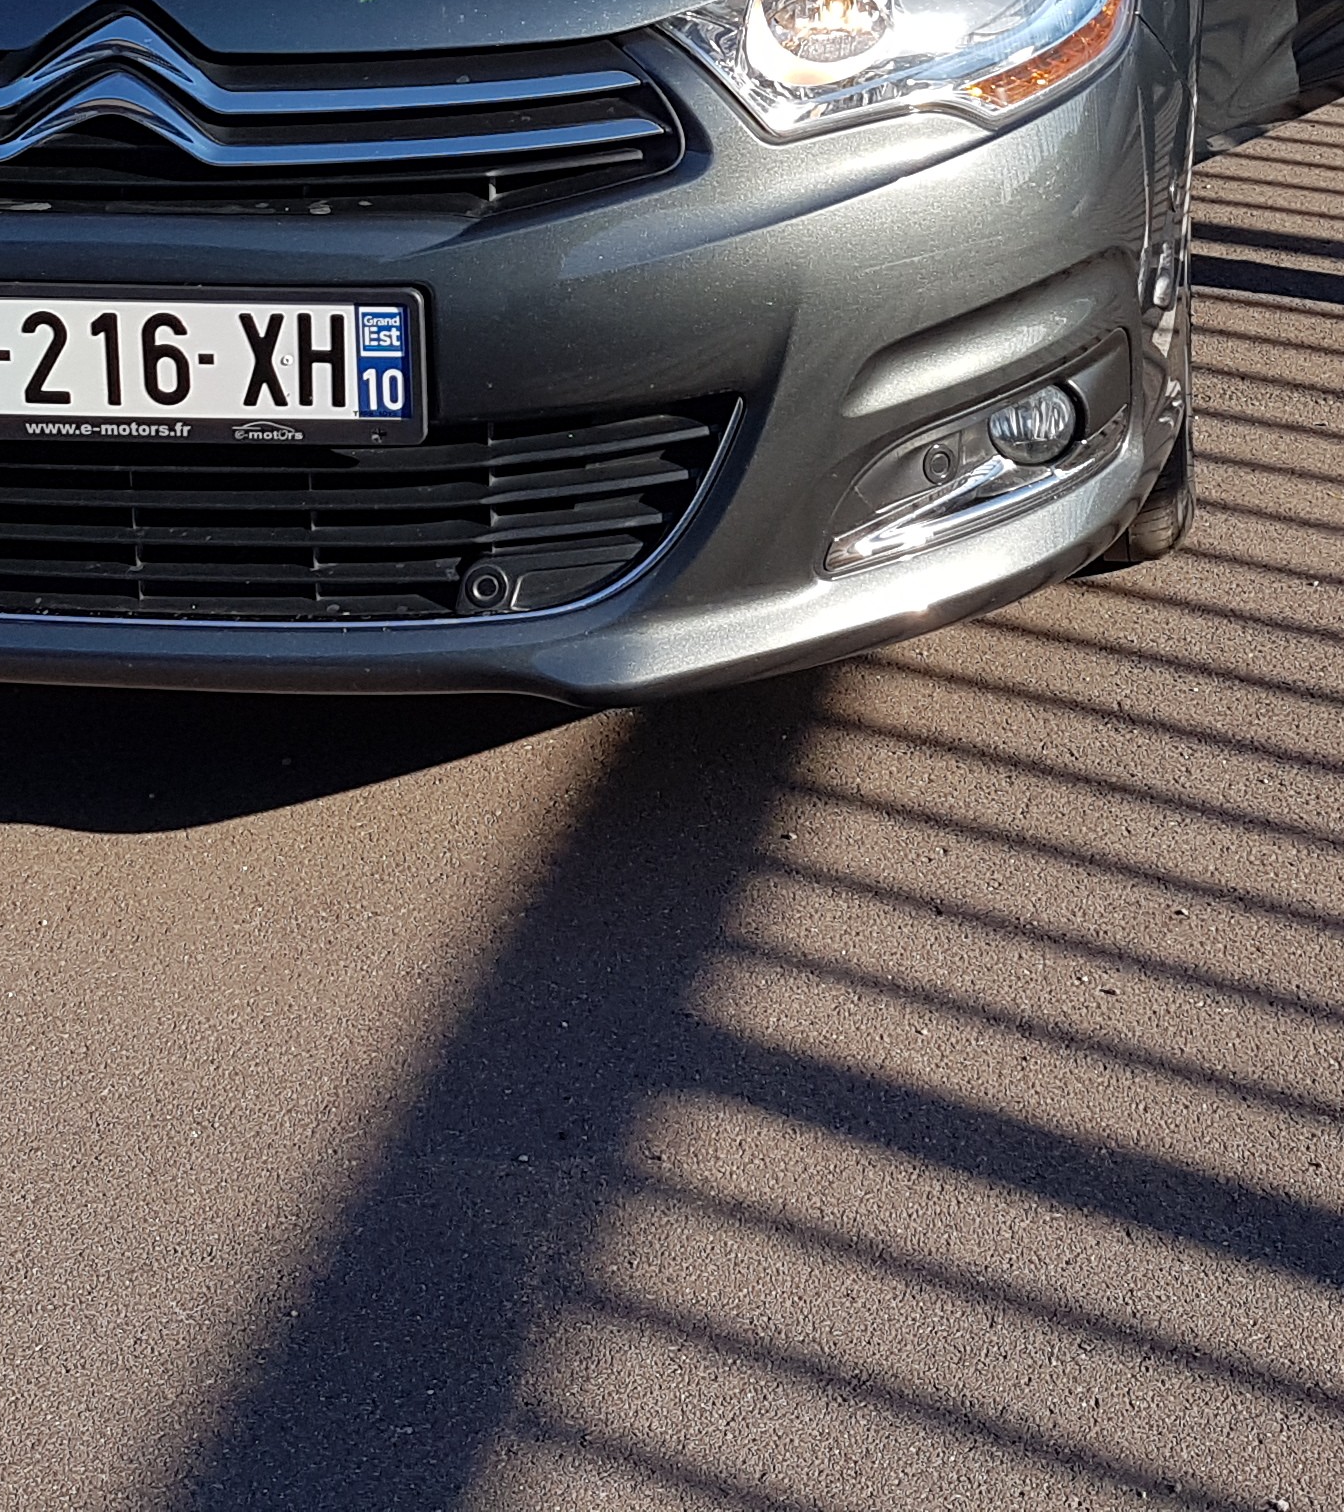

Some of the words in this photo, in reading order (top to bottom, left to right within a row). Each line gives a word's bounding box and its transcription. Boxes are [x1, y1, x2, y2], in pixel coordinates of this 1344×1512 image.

[363, 315, 401, 327] Grand
[364, 327, 401, 346] Est
[362, 368, 405, 411] 10
[25, 421, 192, 437] www.e-motors.fr
